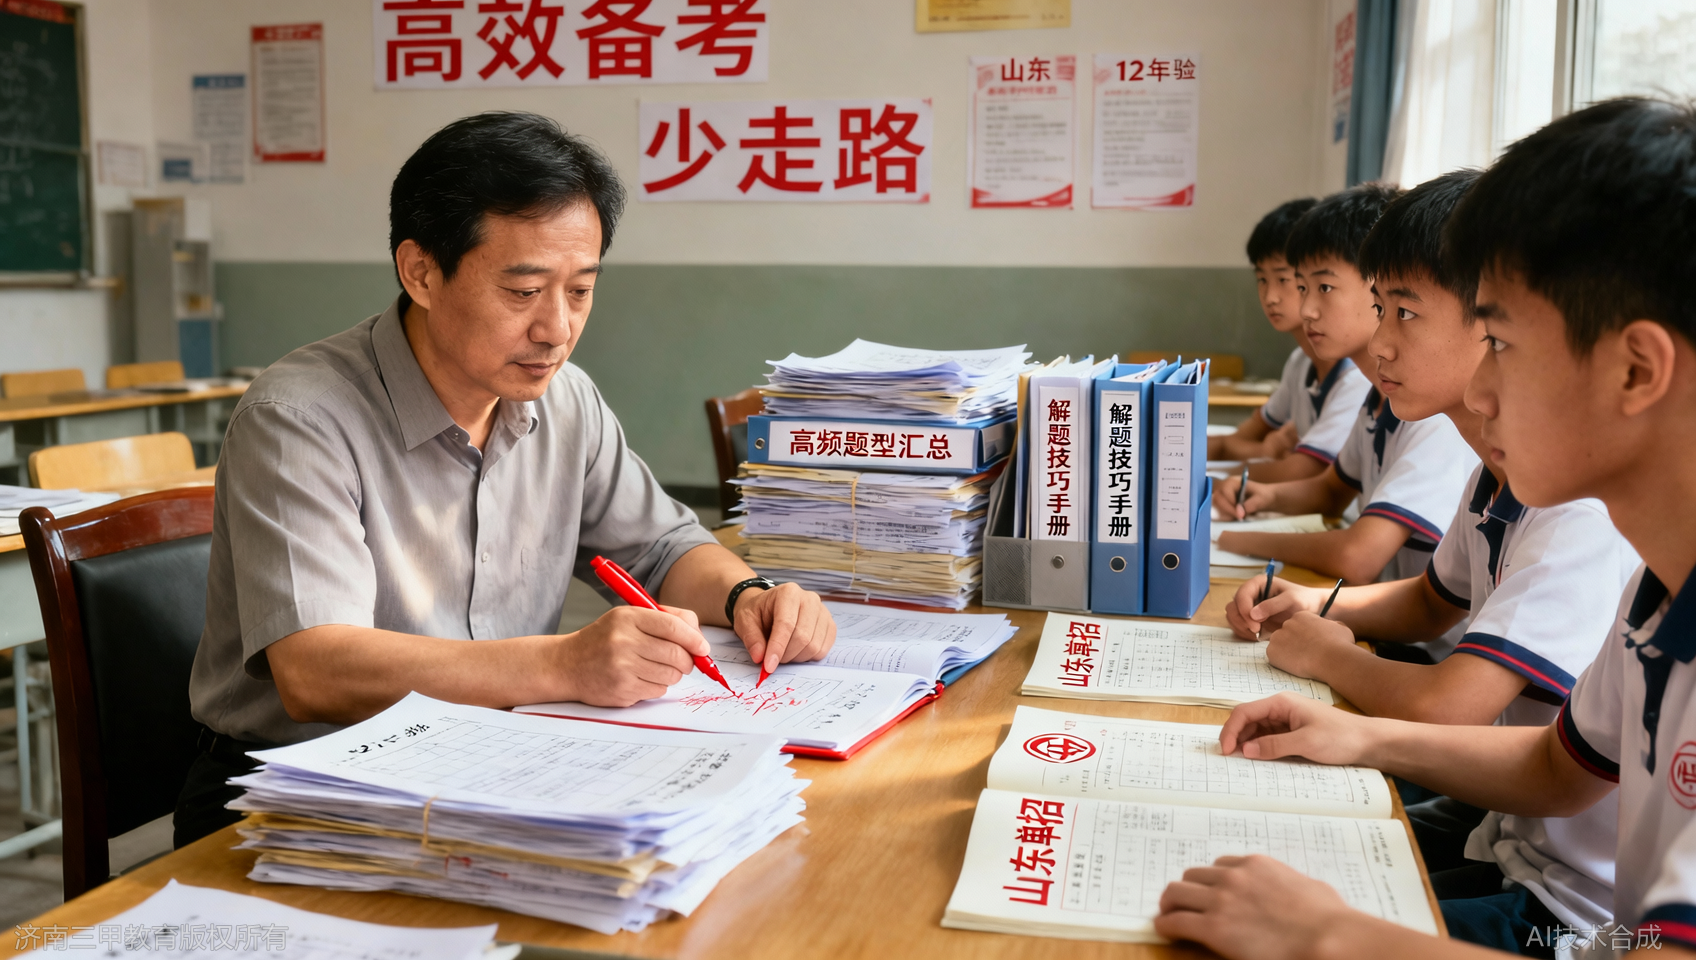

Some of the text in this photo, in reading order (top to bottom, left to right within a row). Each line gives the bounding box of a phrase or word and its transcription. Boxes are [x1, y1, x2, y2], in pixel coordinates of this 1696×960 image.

[386, 0, 766, 82] 高效备考
[1001, 56, 1051, 82] 山东
[1116, 58, 1196, 82] 12年验
[643, 104, 926, 194] 少走路
[790, 429, 952, 460] 高频题型汇总
[1047, 398, 1071, 536] 解题技巧手册
[1108, 402, 1133, 538] 解题技巧手册
